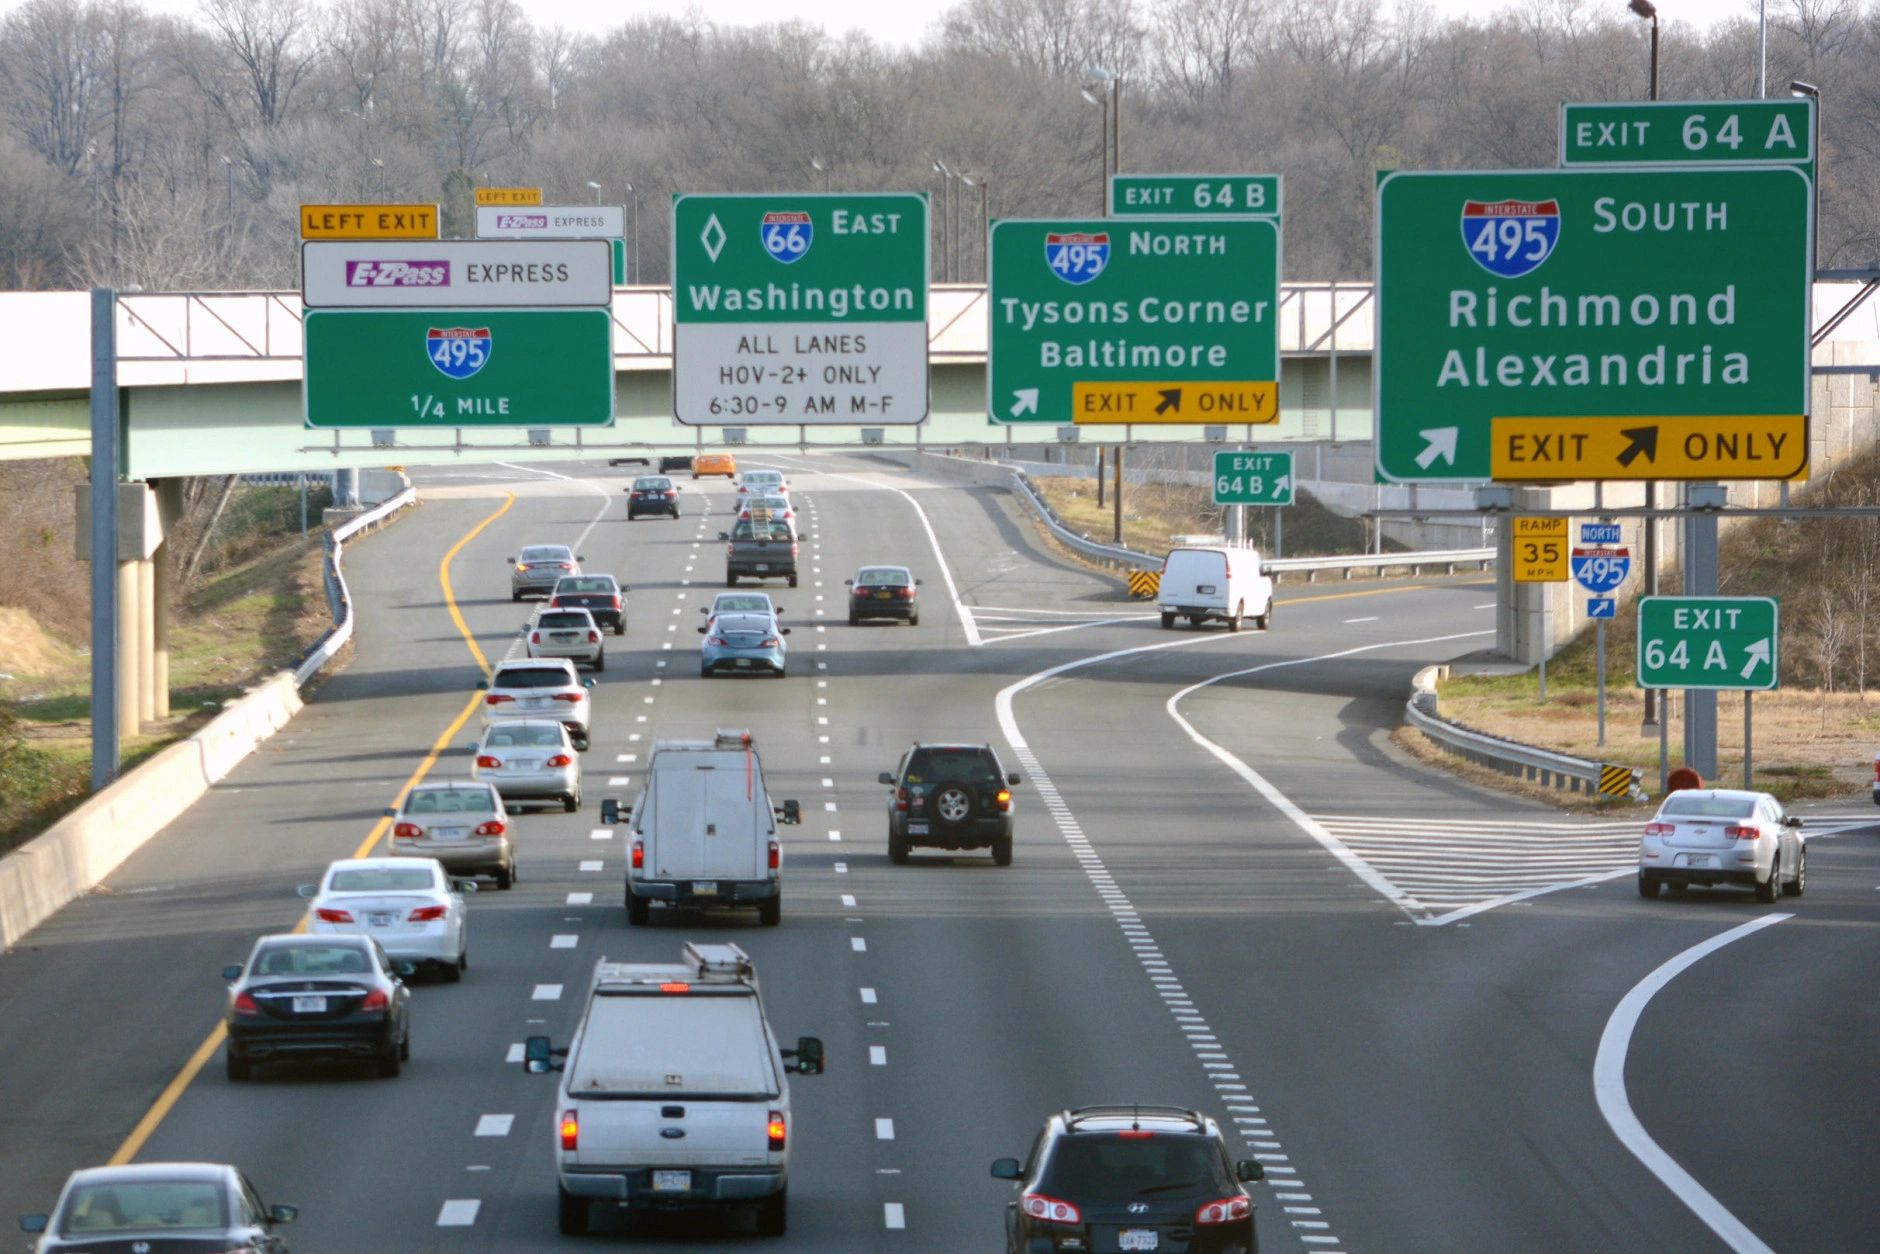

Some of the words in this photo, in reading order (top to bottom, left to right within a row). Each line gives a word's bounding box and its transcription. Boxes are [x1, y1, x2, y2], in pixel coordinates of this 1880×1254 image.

[1576, 121, 1651, 147] EXIT
[1682, 114, 1743, 151] 64
[1763, 113, 1797, 149] A
[478, 193, 505, 202] LEFT
[512, 193, 537, 202] EXIT
[1125, 188, 1174, 205] EXIT
[1193, 184, 1234, 208] 64
[1246, 184, 1265, 207] B
[1483, 204, 1539, 216] INTERSTATE
[307, 214, 364, 230] LEFT
[377, 214, 429, 230] EXIT
[554, 217, 605, 228] EXPRESS
[767, 224, 806, 253] 66
[1472, 219, 1549, 262] 495
[1053, 245, 1103, 274] 495
[467, 264, 569, 283] EXPRESS
[689, 283, 914, 317] Washington
[1449, 285, 1736, 328] Richmond
[1001, 298, 1129, 331] Tysons
[1139, 297, 1267, 323] Corner
[434, 340, 484, 368] 495
[737, 336, 779, 354] ALL
[795, 336, 867, 353] LANES
[1041, 340, 1227, 367] Baltimore
[720, 367, 808, 384] HOV-2+
[823, 366, 882, 384] ONLY
[1436, 345, 1750, 388] Alexandria
[458, 398, 509, 414] MILE
[710, 397, 788, 414] 6:30-9
[804, 397, 836, 413] AM
[851, 397, 894, 413] M-F
[1084, 393, 1136, 411] EXIT
[1199, 393, 1266, 411] ONLY
[1508, 434, 1589, 462] EXIT
[1684, 432, 1788, 461] ONLY
[1232, 458, 1272, 470] EXIT
[1216, 476, 1243, 494] 64
[1249, 476, 1263, 494] B
[1520, 520, 1561, 530] RAMP
[1582, 527, 1619, 541] NORTH
[1523, 543, 1559, 563] 35
[1527, 569, 1554, 577] MPH
[1577, 559, 1624, 585] 495
[1674, 608, 1742, 630] EXIT
[1645, 639, 1690, 670] 64
[1703, 640, 1728, 670] A
